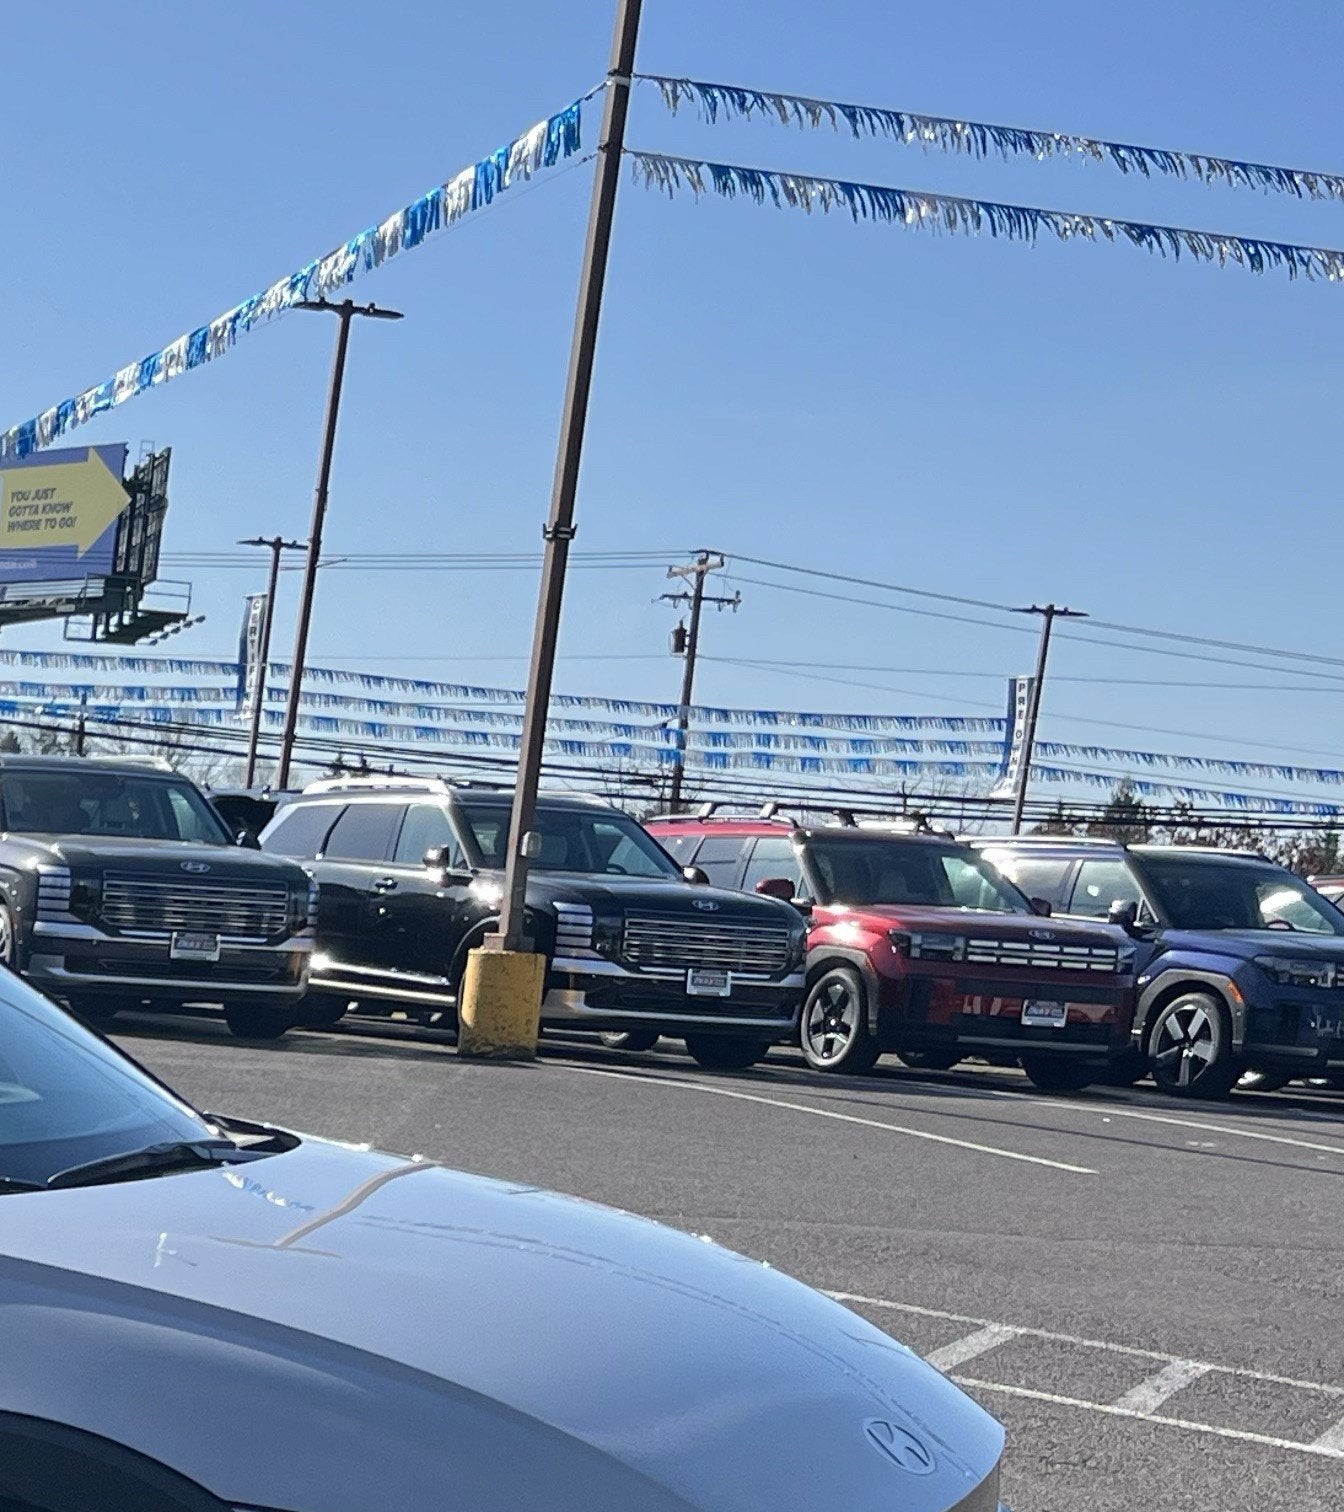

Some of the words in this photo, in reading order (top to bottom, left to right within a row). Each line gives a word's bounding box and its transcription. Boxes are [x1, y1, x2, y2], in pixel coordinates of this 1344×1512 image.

[10, 490, 30, 503] YOU
[33, 487, 57, 501] JUST
[8, 504, 39, 518] GOTTA
[41, 501, 74, 515] KNOW
[6, 519, 43, 533] WHERE
[44, 517, 57, 530] TO
[58, 516, 78, 529] GO!
